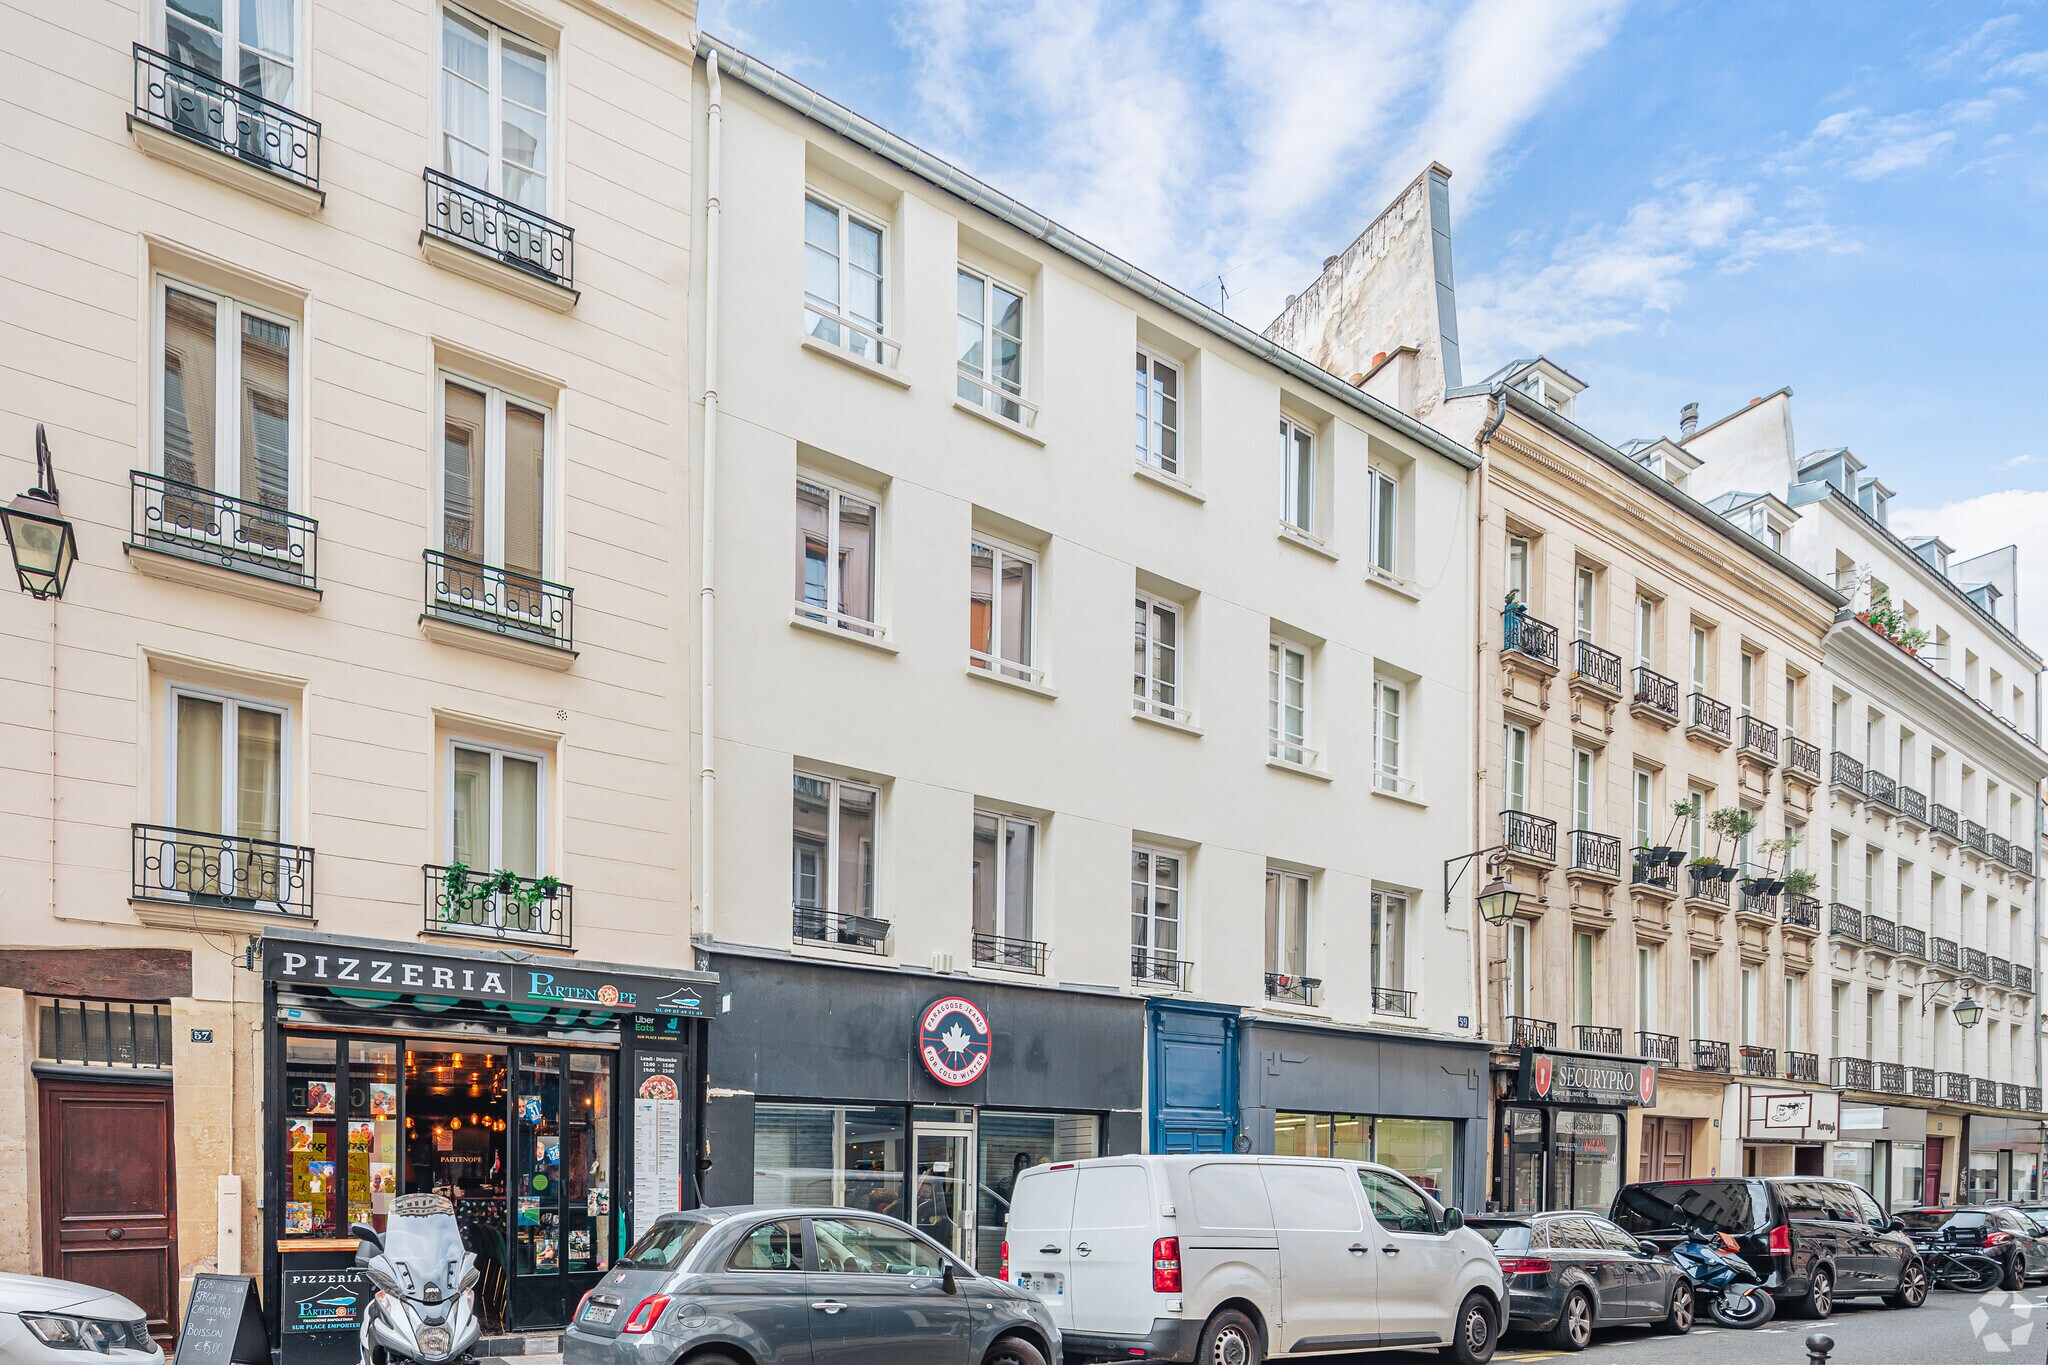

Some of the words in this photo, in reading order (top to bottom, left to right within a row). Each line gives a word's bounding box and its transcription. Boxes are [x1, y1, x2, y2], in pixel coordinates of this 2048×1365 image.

[282, 952, 506, 994] PIZZERIA
[635, 1015, 655, 1024] Uber
[928, 1002, 963, 1027] PARAGOOSE
[965, 1007, 984, 1028] JEANS
[635, 1023, 655, 1032] Eats
[1459, 1017, 1468, 1027] 59
[193, 1031, 210, 1040] 57
[927, 1050, 938, 1068] FOR
[938, 1068, 958, 1080] COLD
[960, 1055, 985, 1080] WINTER
[1559, 1066, 1634, 1092] SECURYPRO
[292, 1274, 362, 1284] PIZZERIA
[187, 1322, 224, 1338] BOISSON
